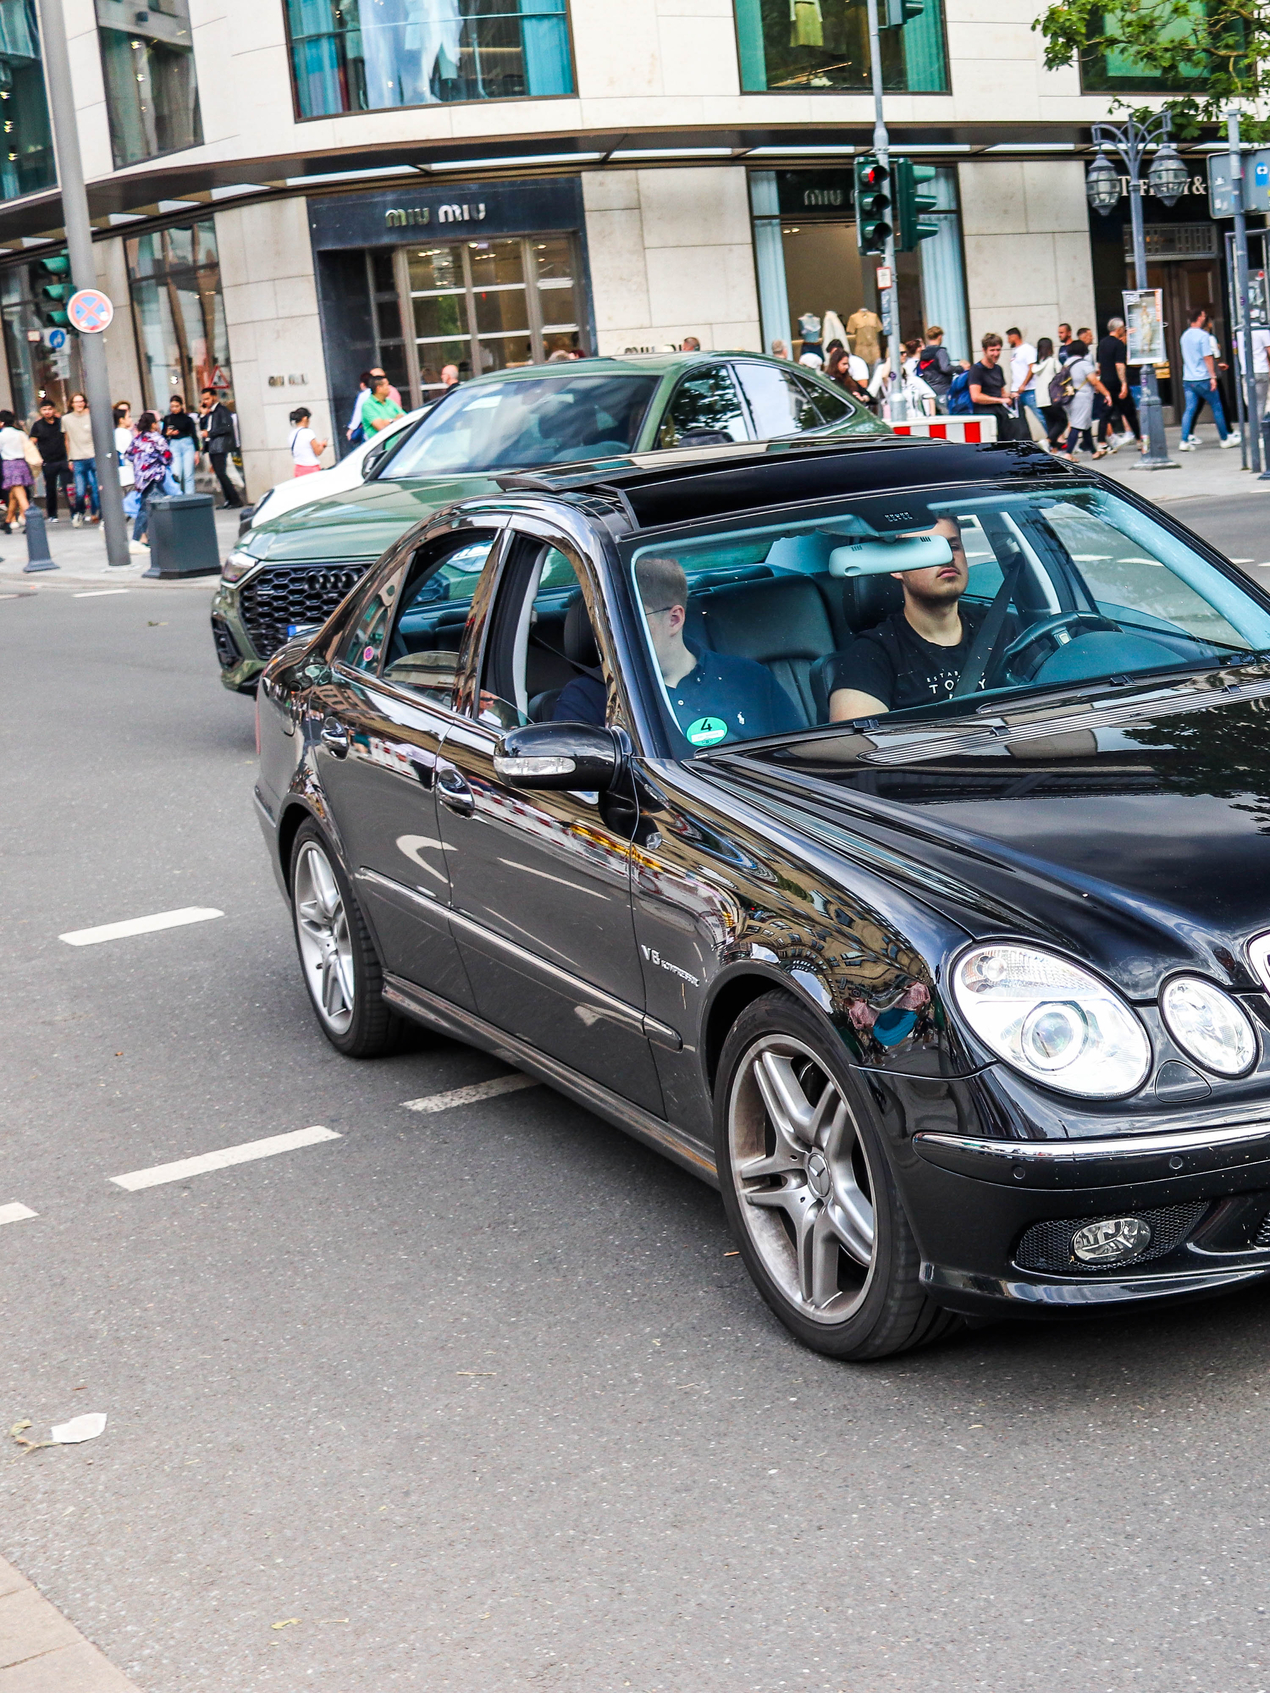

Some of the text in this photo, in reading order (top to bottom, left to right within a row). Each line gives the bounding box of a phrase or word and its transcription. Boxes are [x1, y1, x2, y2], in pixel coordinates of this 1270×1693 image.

[804, 189, 842, 206] MIU
[385, 203, 486, 228] MIU MIU
[701, 718, 712, 731] 4
[641, 944, 661, 966] V8
